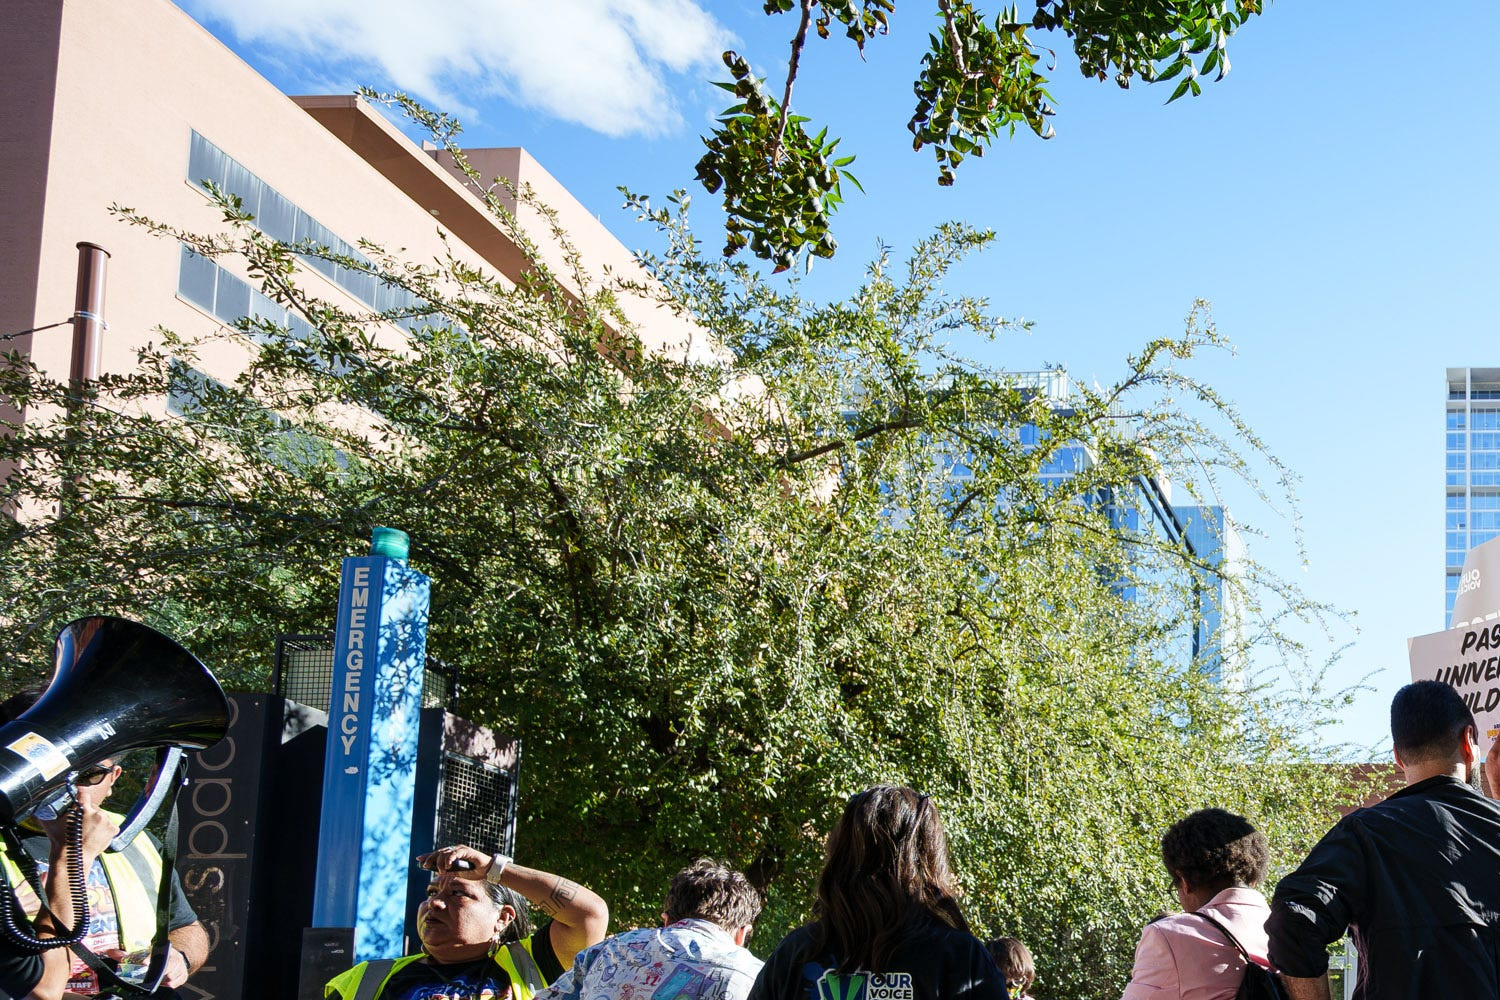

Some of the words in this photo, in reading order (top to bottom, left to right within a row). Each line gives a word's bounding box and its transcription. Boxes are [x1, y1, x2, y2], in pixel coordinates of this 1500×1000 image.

[341, 567, 370, 756] EMERGENCY
[870, 974, 911, 988] OUR
[870, 988, 912, 1000] VOICE
